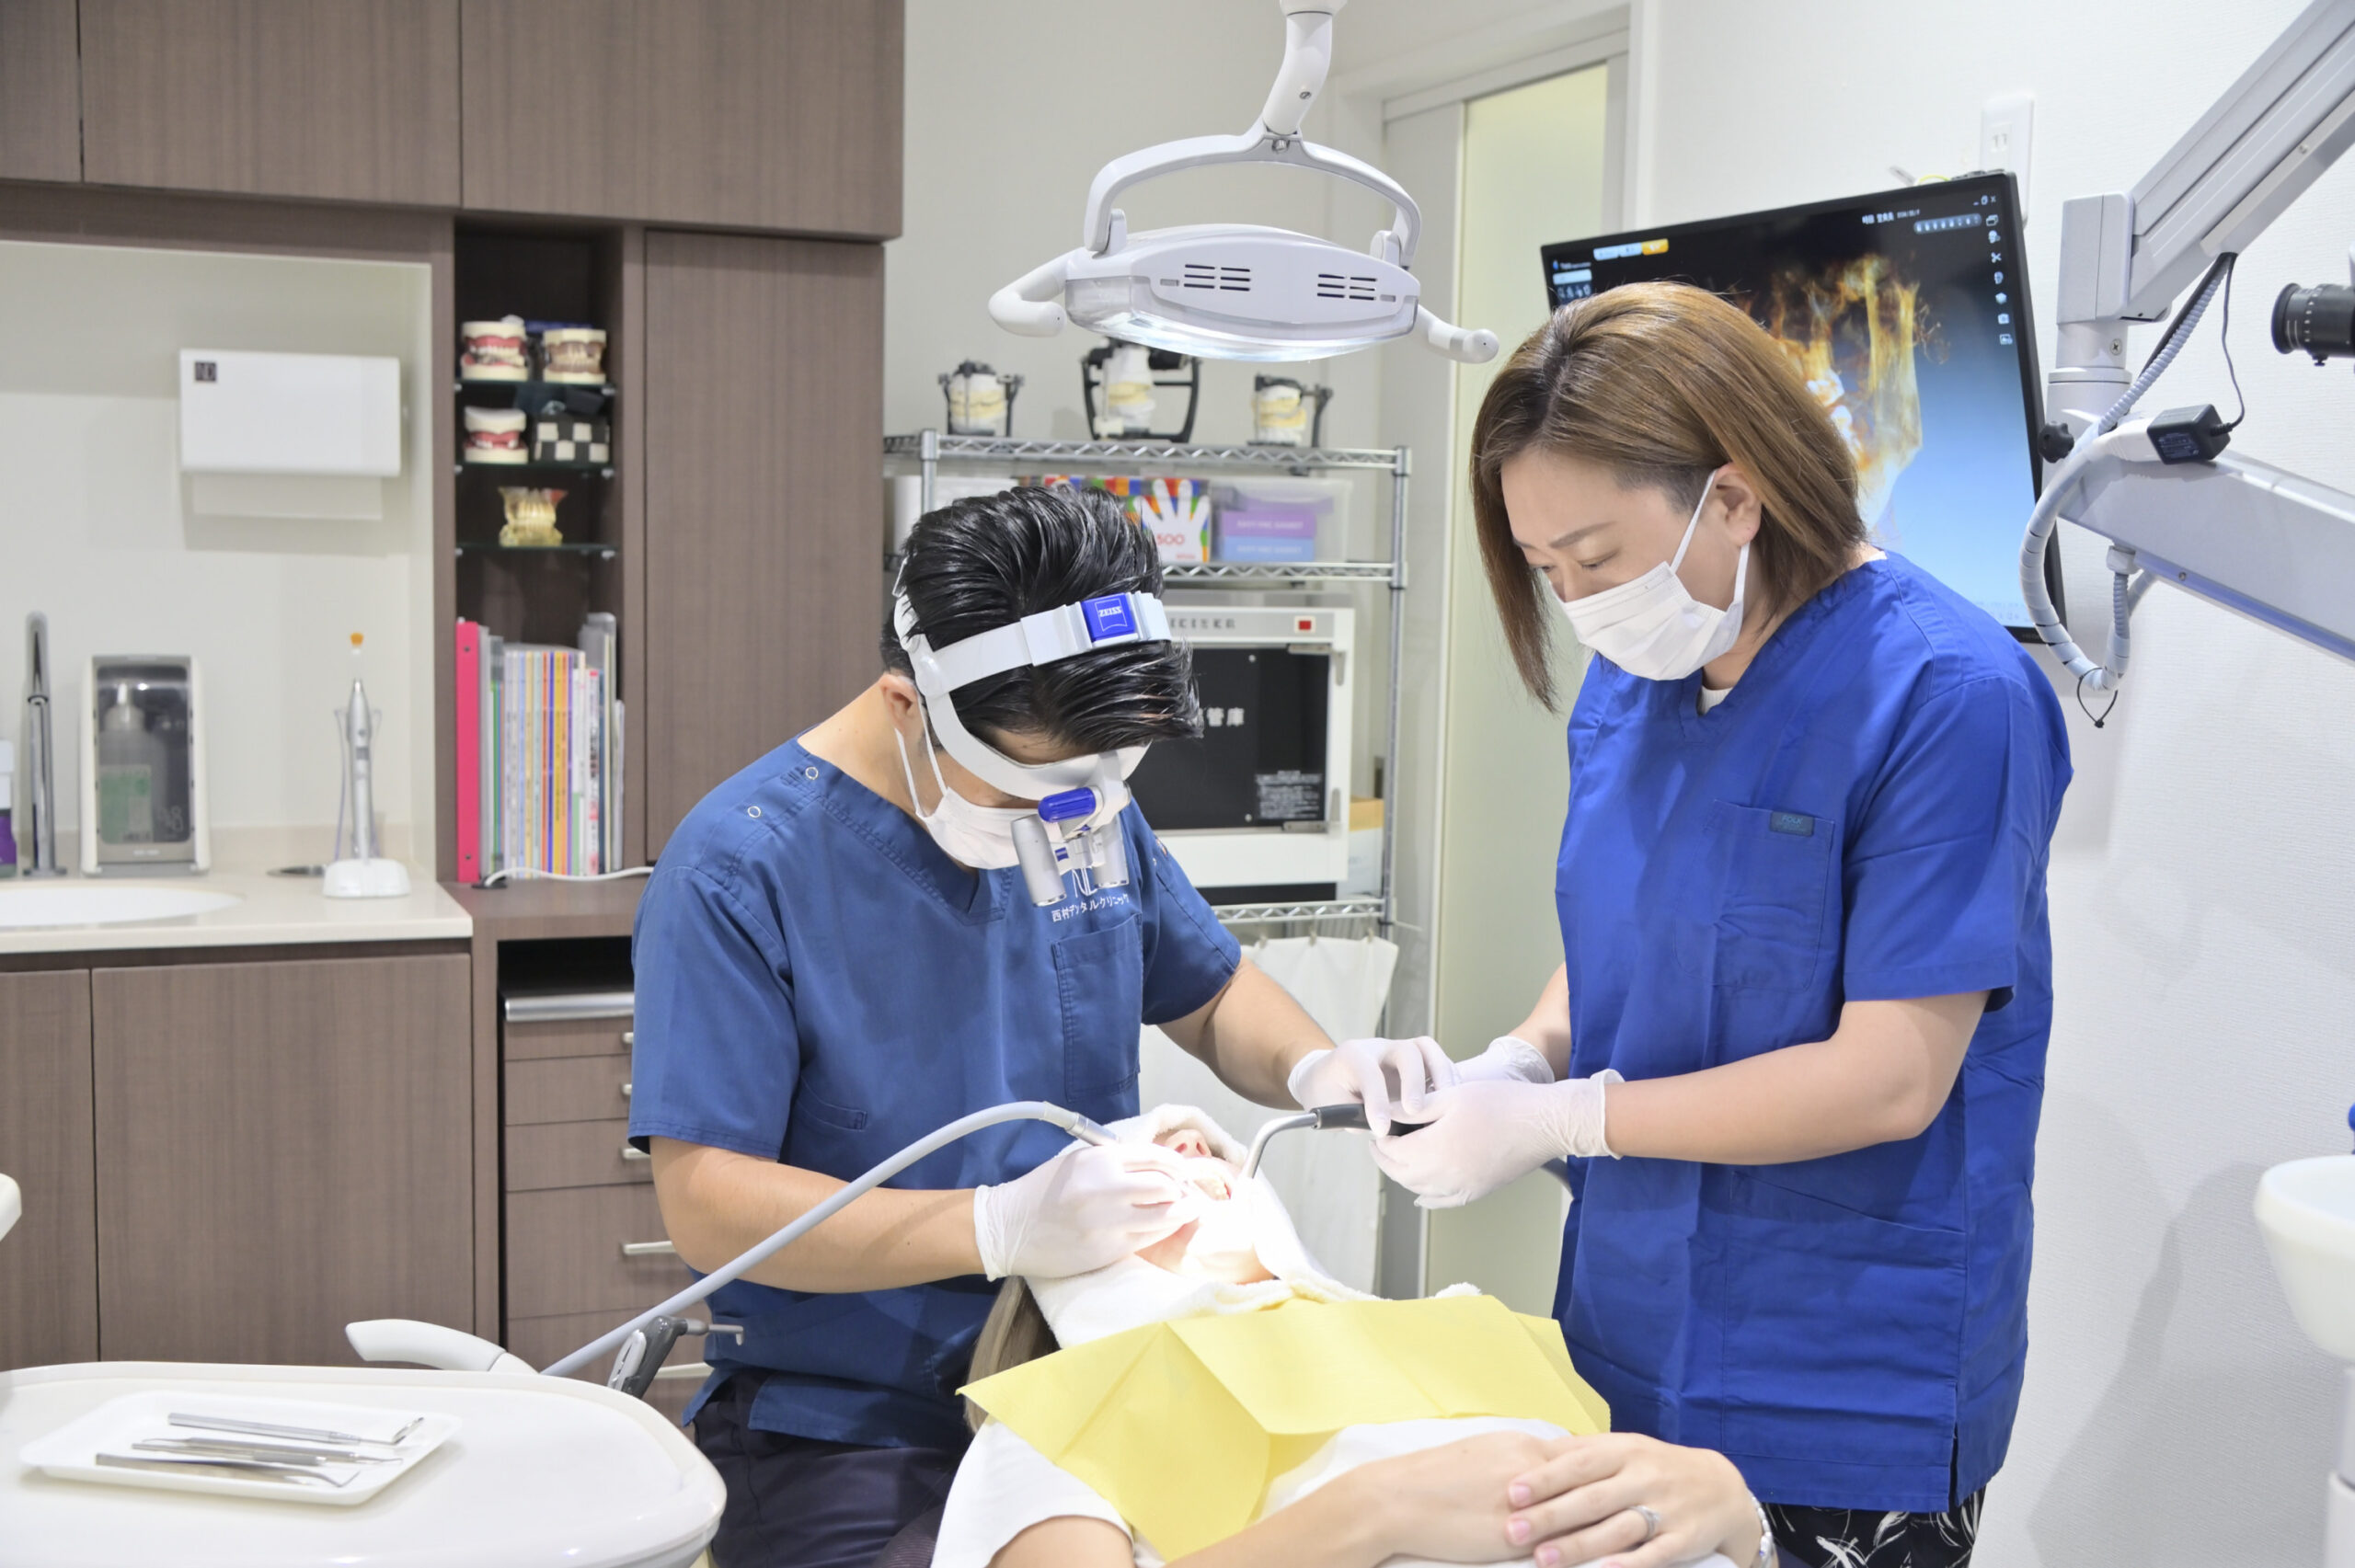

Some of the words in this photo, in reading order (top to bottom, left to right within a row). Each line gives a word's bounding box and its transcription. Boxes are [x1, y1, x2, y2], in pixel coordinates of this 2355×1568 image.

[1098, 606, 1122, 617] ZEISS
[1051, 894, 1129, 922] 西村デンタルクリニック
